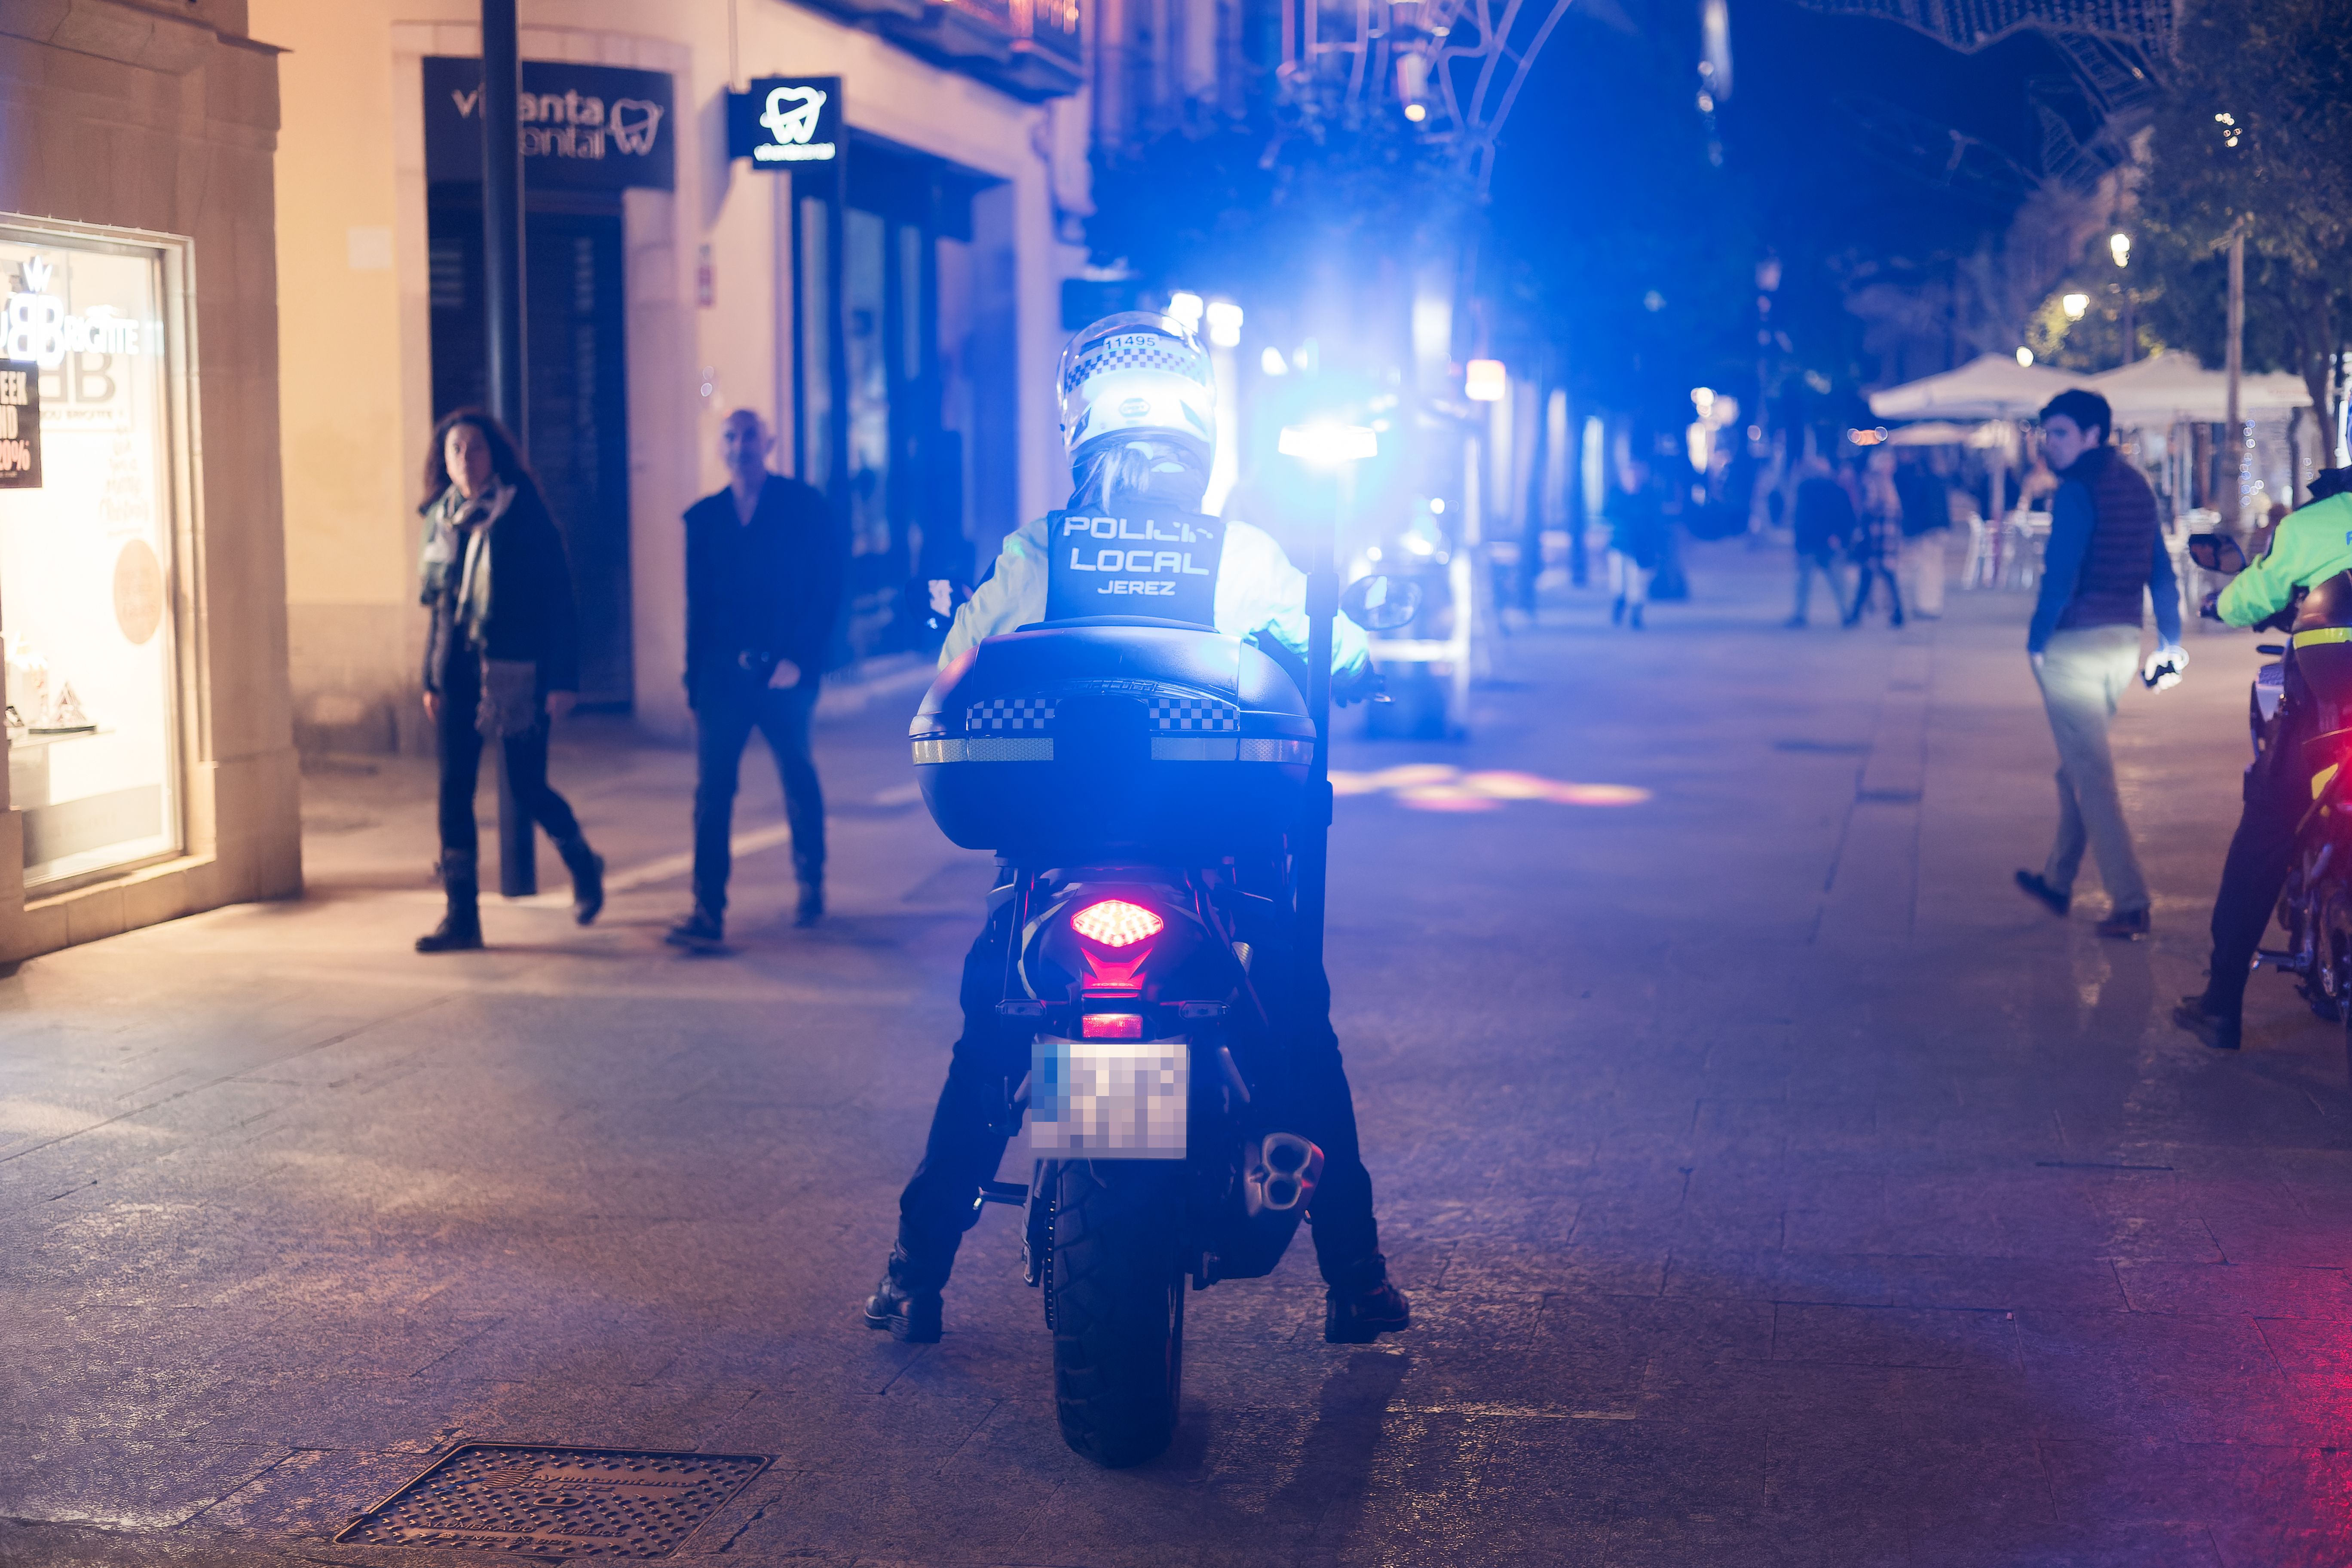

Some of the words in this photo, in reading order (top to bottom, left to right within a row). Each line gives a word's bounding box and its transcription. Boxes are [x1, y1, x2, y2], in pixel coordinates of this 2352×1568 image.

[451, 83, 604, 125] vianta
[1106, 337, 1155, 349] 11495
[1070, 548, 1209, 576] LOCAL
[1097, 580, 1176, 596] JEREZ
[419, 1522, 536, 1533] ALUMBRADO
[547, 1528, 627, 1537] PUBLICO
